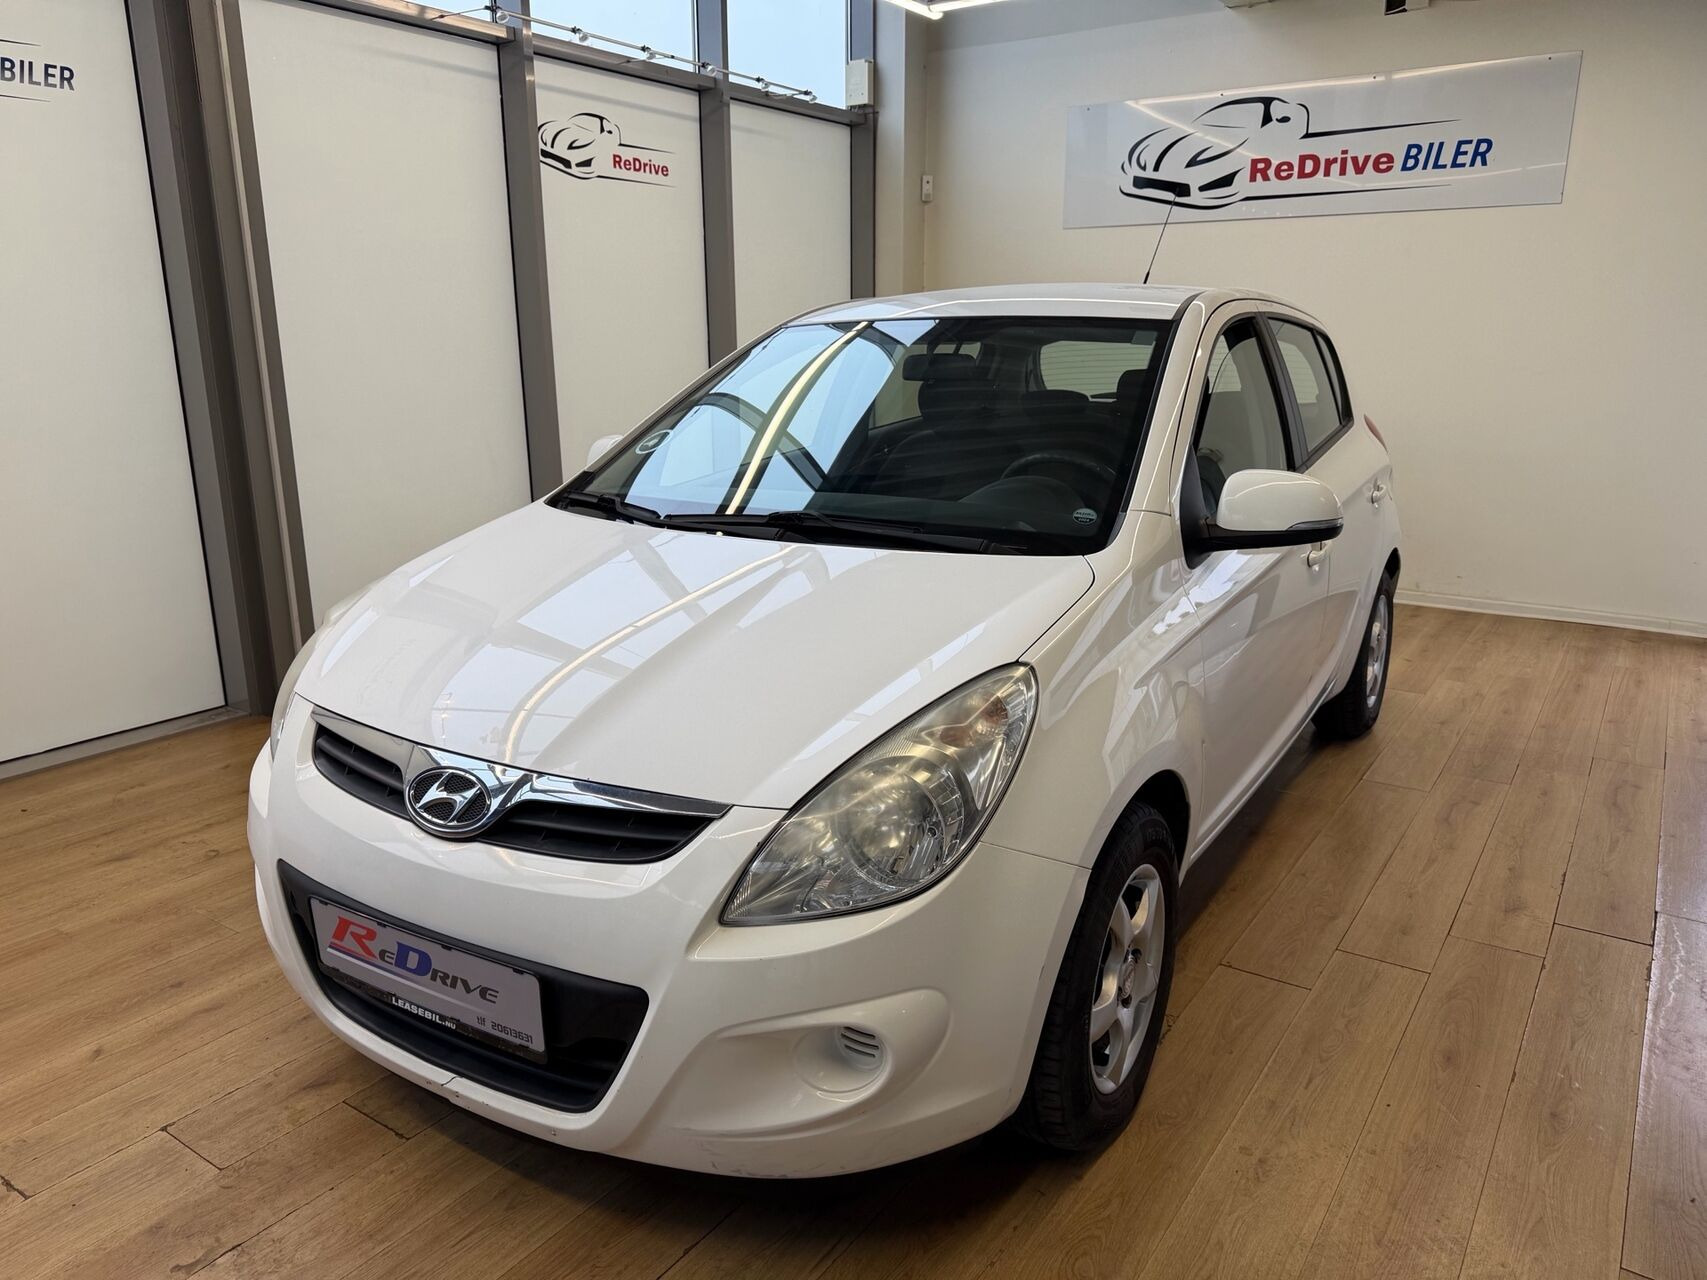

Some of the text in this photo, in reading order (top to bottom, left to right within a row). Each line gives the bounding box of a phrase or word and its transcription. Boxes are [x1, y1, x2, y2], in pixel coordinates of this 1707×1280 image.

[0, 56, 75, 91] BILER
[612, 153, 670, 177] ReDrive
[1249, 138, 1494, 183] ReDrive BILER
[391, 996, 457, 1030] LEASEBIL.NU
[491, 1020, 534, 1045] 20613631
